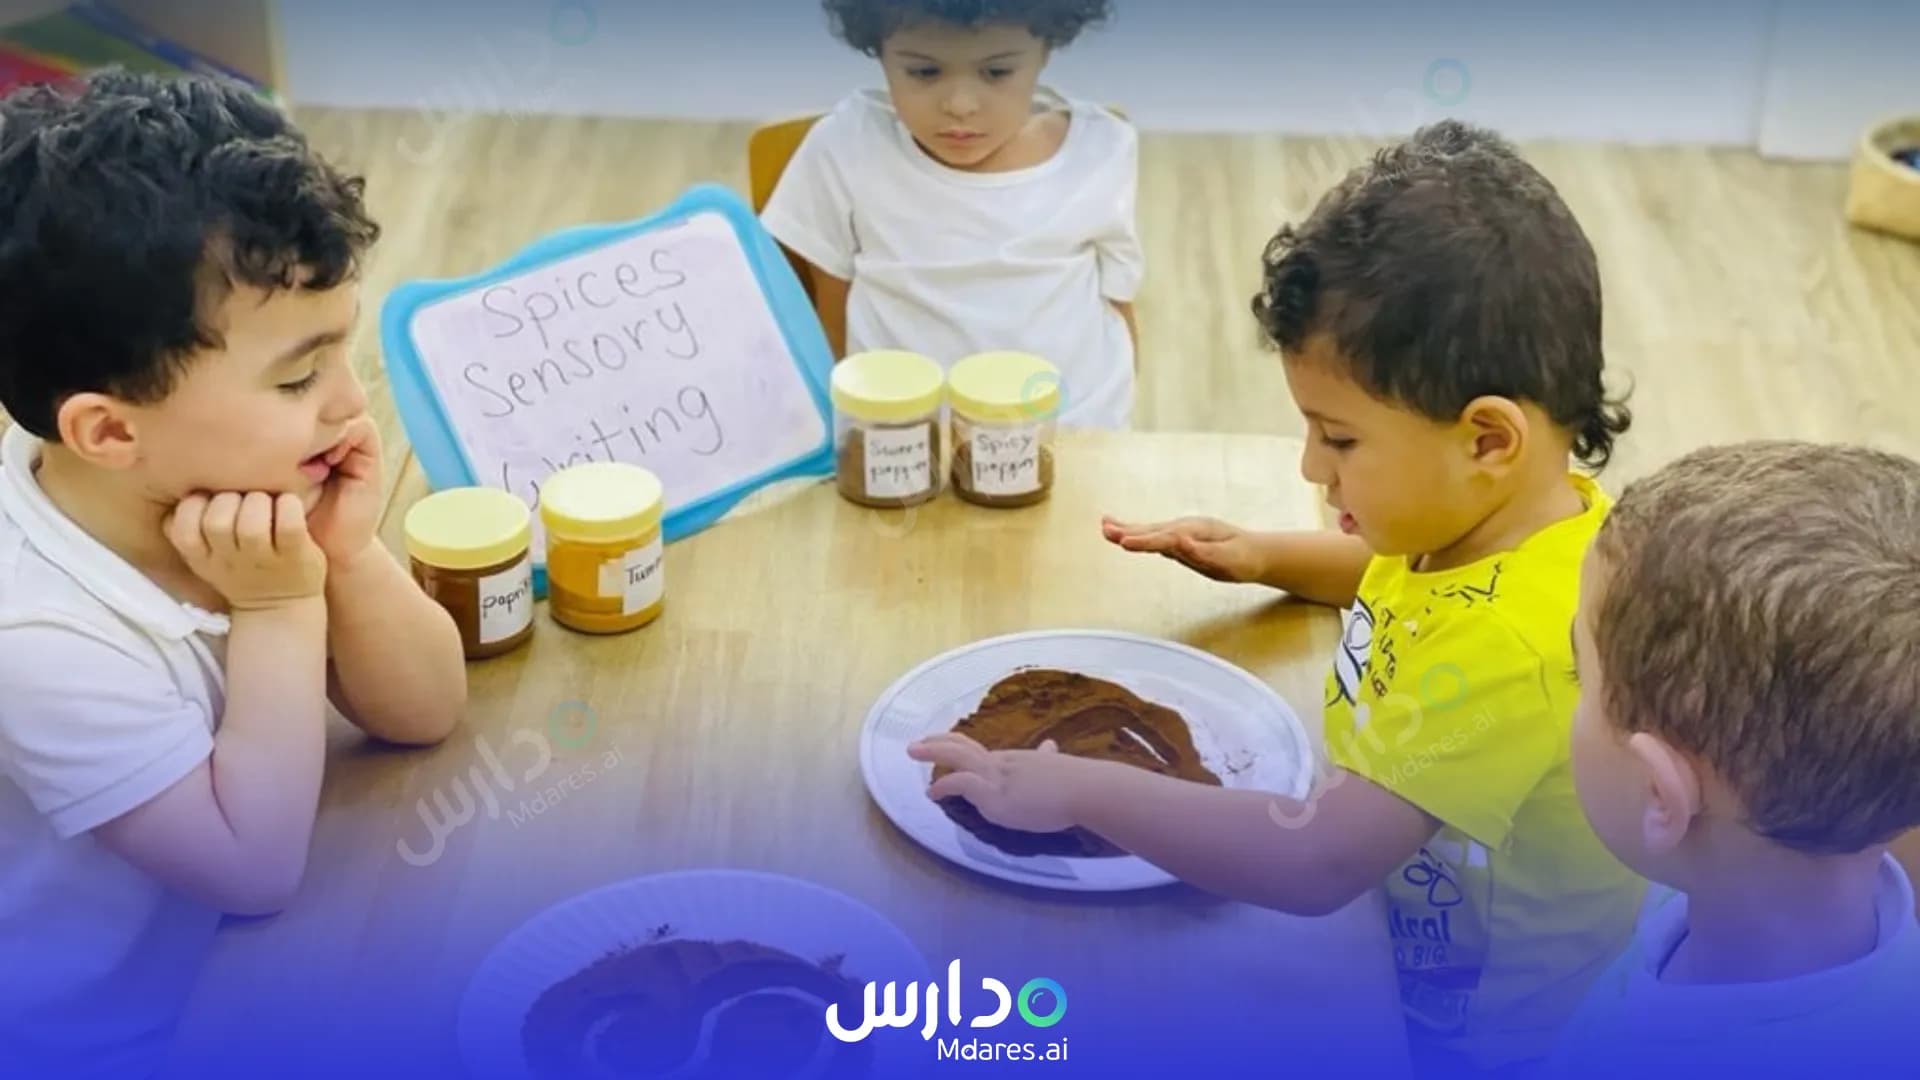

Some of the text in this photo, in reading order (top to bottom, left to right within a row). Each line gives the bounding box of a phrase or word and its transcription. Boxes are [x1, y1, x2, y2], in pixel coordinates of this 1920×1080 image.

[481, 248, 687, 349] Spices
[463, 301, 700, 419] Sensory
[976, 434, 1034, 455] Spicy
